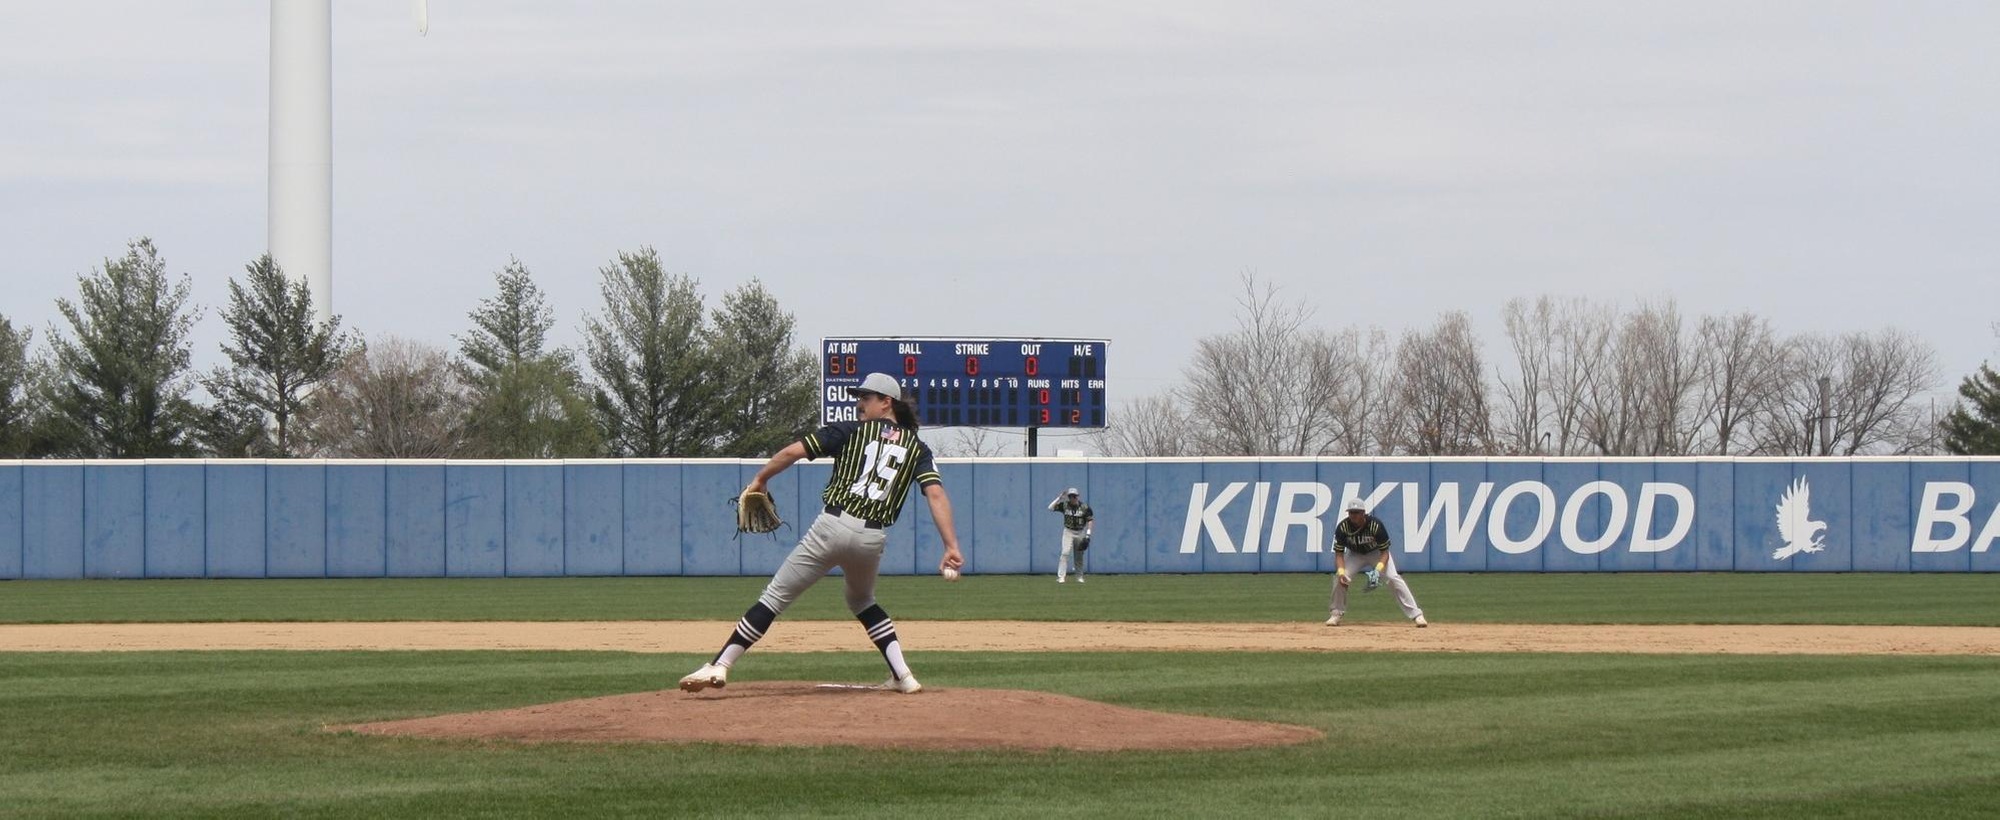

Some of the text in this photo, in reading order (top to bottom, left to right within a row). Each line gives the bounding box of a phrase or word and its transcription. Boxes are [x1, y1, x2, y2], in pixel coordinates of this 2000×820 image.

[828, 343, 858, 354] AT BAT
[899, 343, 921, 354] BALL
[955, 343, 989, 355] STRIKE
[1021, 344, 1041, 355] OUT
[1074, 344, 1091, 356] H/E
[905, 356, 916, 375] 0
[967, 356, 978, 375] 0
[1026, 356, 1037, 375] 0
[901, 379, 1104, 388] 2 3 4 5 6 7 8 9 10 RUNS HITS ERR
[1040, 389, 1049, 404] 0
[826, 406, 858, 423] EAGL
[1041, 409, 1049, 423] 3
[1071, 409, 1080, 423] 2
[850, 440, 907, 501] 15
[1180, 481, 1694, 554] KIRKWOOD
